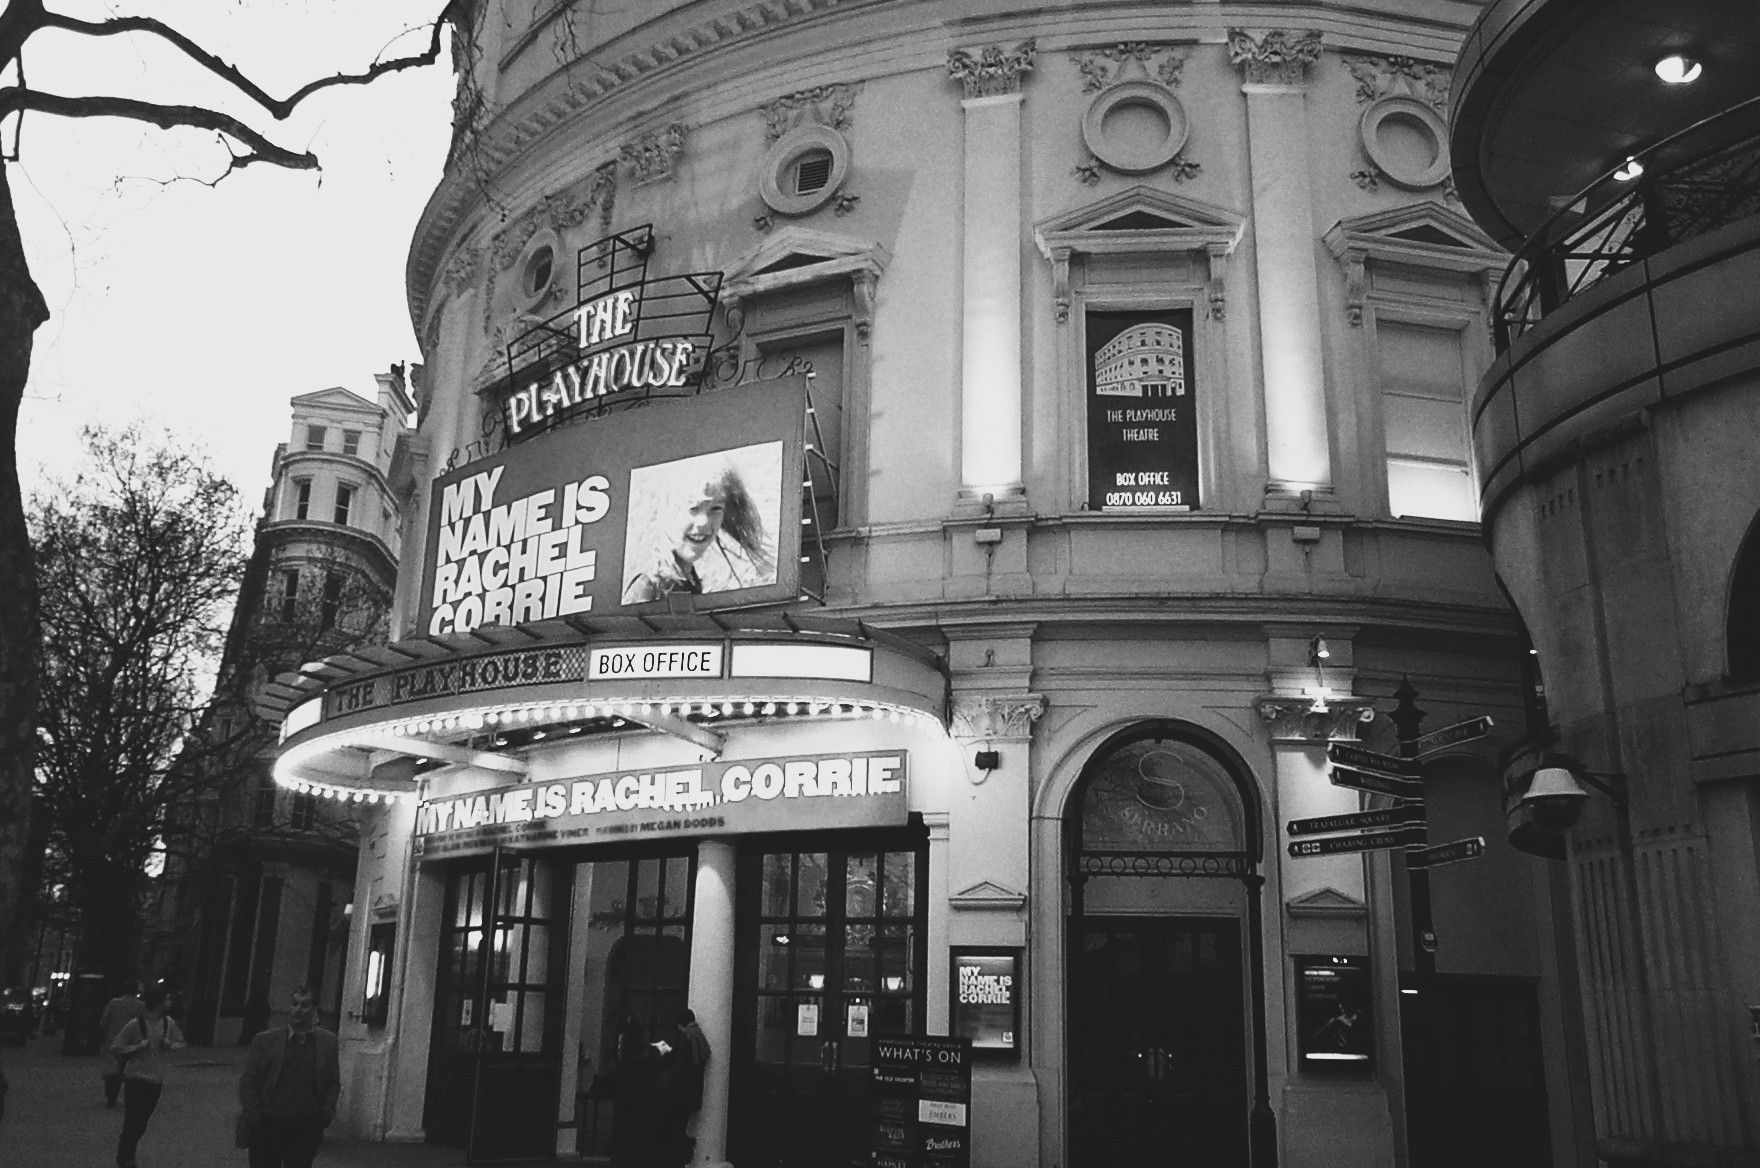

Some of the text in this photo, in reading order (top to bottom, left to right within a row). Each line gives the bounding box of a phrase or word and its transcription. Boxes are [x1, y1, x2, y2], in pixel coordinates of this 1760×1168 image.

[574, 291, 634, 349] THE
[509, 342, 692, 433] PLAYHOUSE
[1106, 408, 1176, 422] THE PLAYHOUSE
[1122, 428, 1159, 441] THEATRE
[1116, 471, 1169, 486] BOX OFFICE
[441, 465, 504, 526] MY
[1106, 491, 1181, 506] 0870 060 6631
[438, 476, 611, 566] NAME IS
[432, 524, 596, 608] RACHEL
[429, 566, 596, 636] CORRIE
[599, 651, 711, 675] BOX OFFICE
[335, 682, 376, 712] THE
[416, 800, 453, 836] MY
[451, 789, 532, 832] NAME
[532, 784, 567, 820] IS
[568, 769, 715, 817] RACHEL
[720, 757, 901, 803] CORRIE
[959, 966, 981, 977] MY
[959, 975, 1012, 986] NAME IS
[959, 993, 1011, 1004] CORRIE
[879, 1046, 960, 1064] WHAT'S ON
